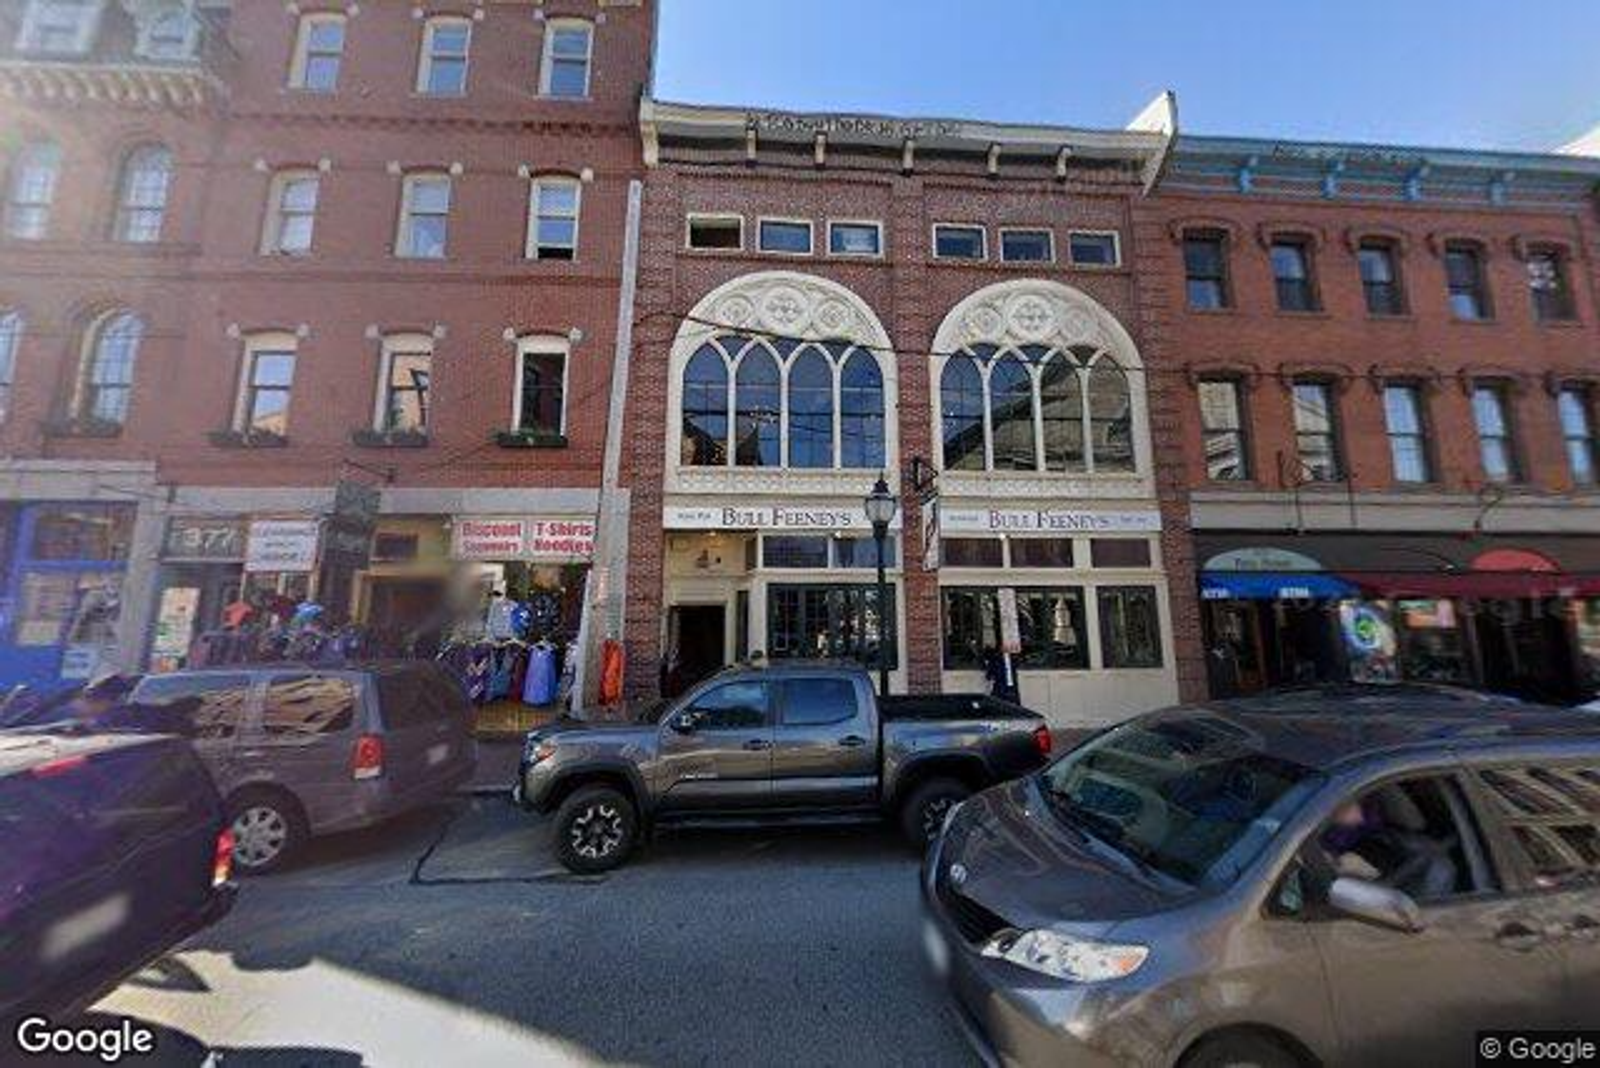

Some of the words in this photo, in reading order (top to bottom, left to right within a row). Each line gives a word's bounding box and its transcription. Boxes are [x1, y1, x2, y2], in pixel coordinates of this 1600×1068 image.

[722, 507, 768, 526] BULL
[772, 507, 851, 526] FEENEY'S
[990, 510, 1033, 528] BULL
